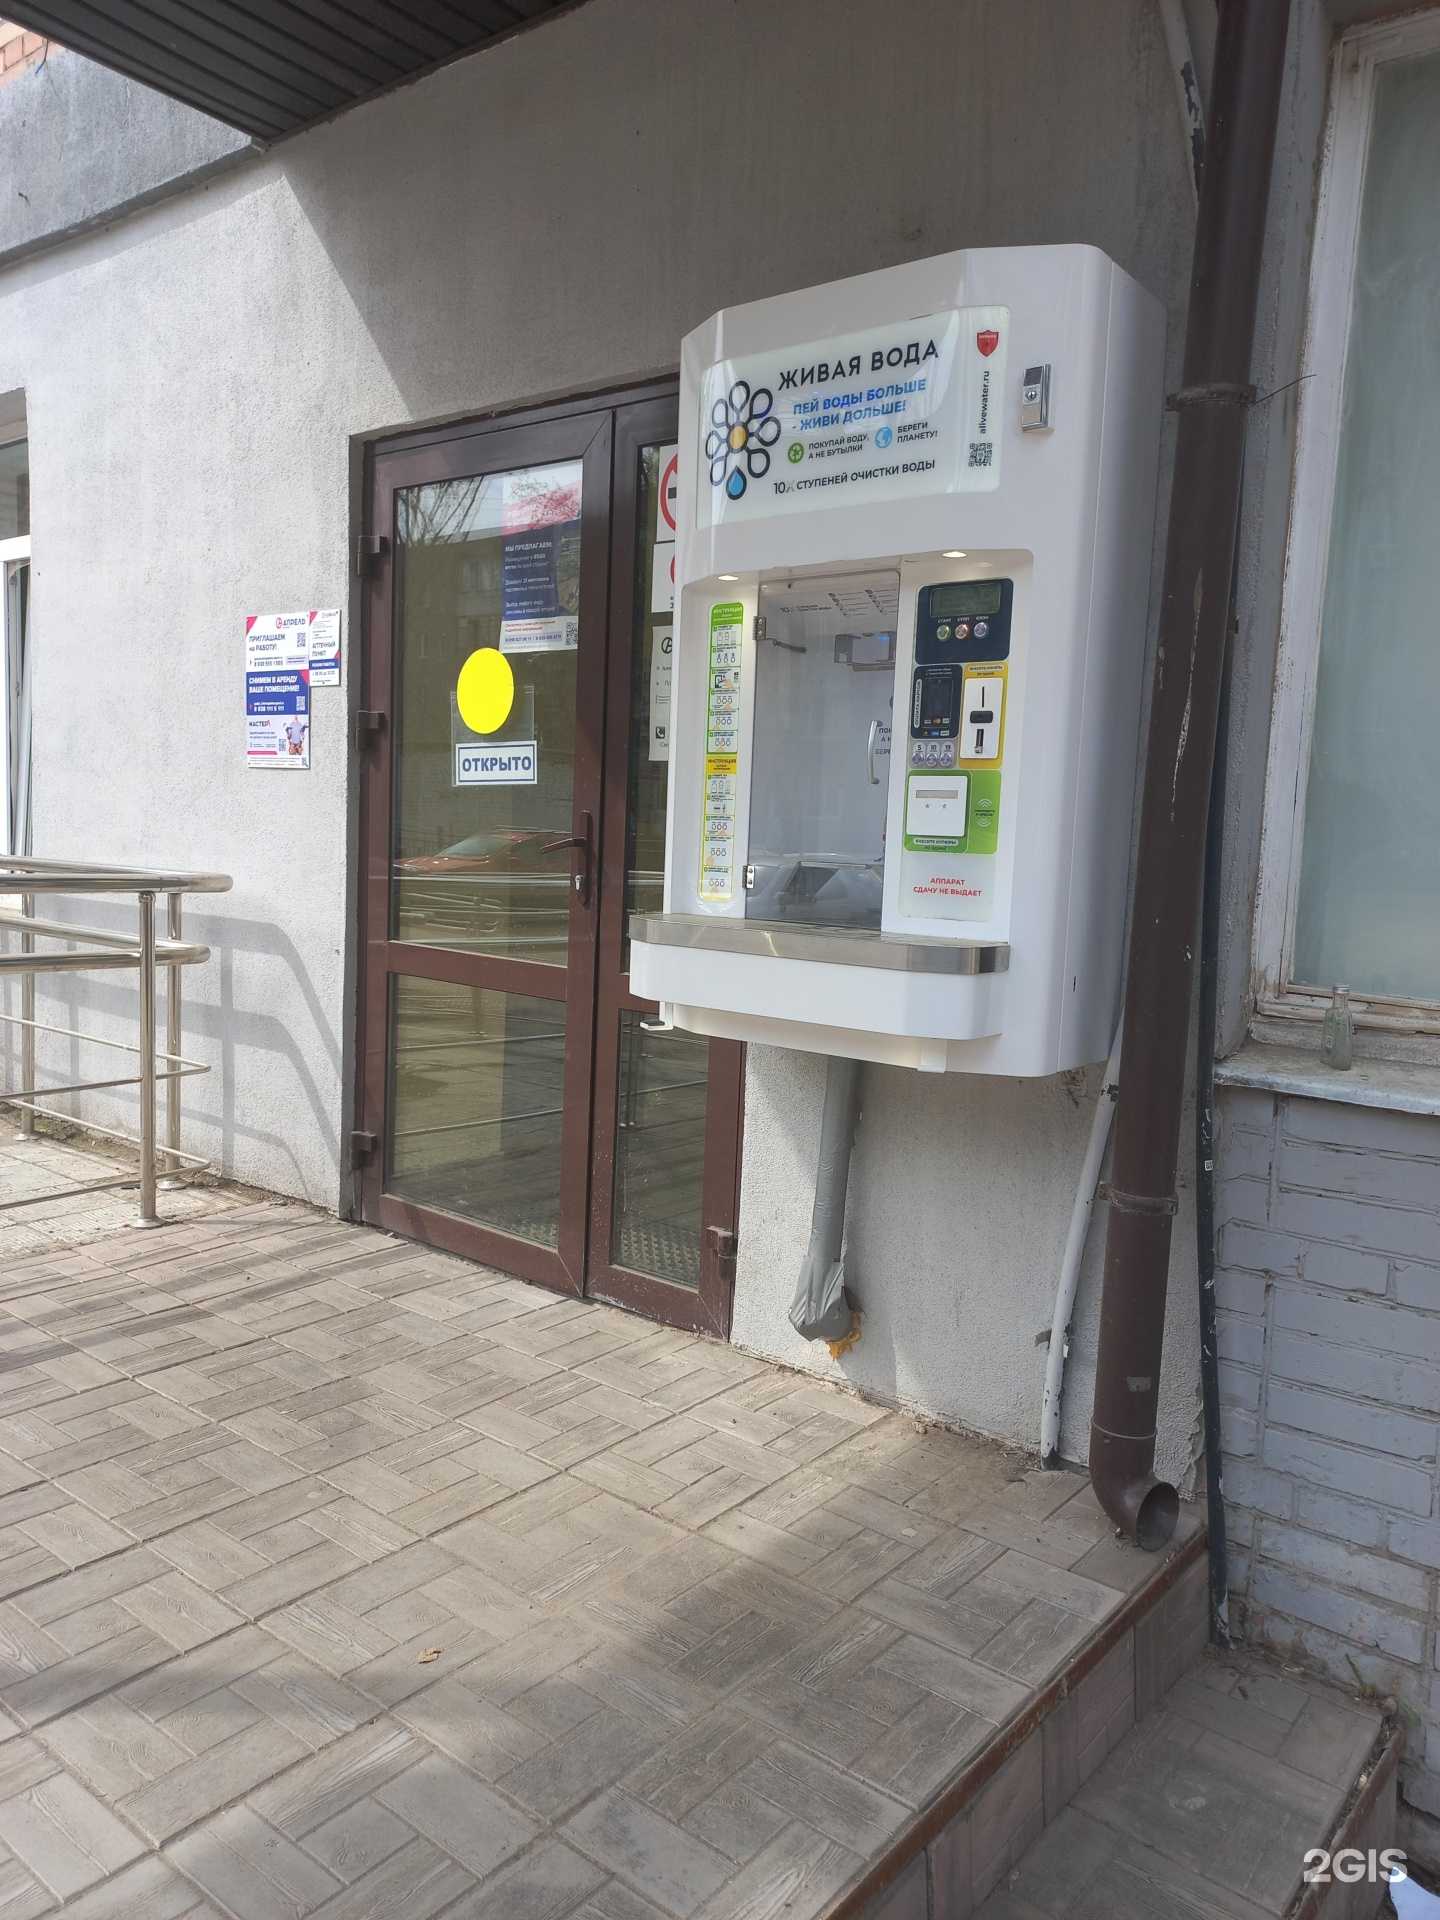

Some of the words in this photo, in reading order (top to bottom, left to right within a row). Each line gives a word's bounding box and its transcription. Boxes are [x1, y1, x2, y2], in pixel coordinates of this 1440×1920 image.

[778, 355, 861, 390] ЖИВАЯ
[871, 339, 938, 371] ВОДА
[793, 399, 819, 415] ПЕЙ
[823, 392, 862, 410] ВОДЫ
[867, 379, 926, 401] БОЛЬШЕ
[979, 371, 989, 434] alivewater.ru
[800, 415, 839, 430] ЖИВИ
[843, 400, 906, 424] ДОЛЬШЕ!
[897, 421, 928, 433] БЕРЕГИ
[808, 437, 845, 450] ПОКУПАЙ
[897, 430, 938, 443] ПЛАНЕТУ!
[816, 450, 825, 458] НЕ
[827, 444, 863, 457] БУТЫЛКИ
[797, 473, 848, 490] СТУПЕНЕЙ
[851, 465, 899, 482] ОЧИСТКИ
[902, 460, 935, 473] ВОДЫ
[249, 634, 285, 642] ПРИГЛАШАЕМ
[462, 756, 532, 772] ОТКРЫТО
[930, 878, 965, 886] АППАРАТ
[913, 886, 937, 894] СДАЧУ
[950, 888, 982, 897] ВЫДАЕТ
